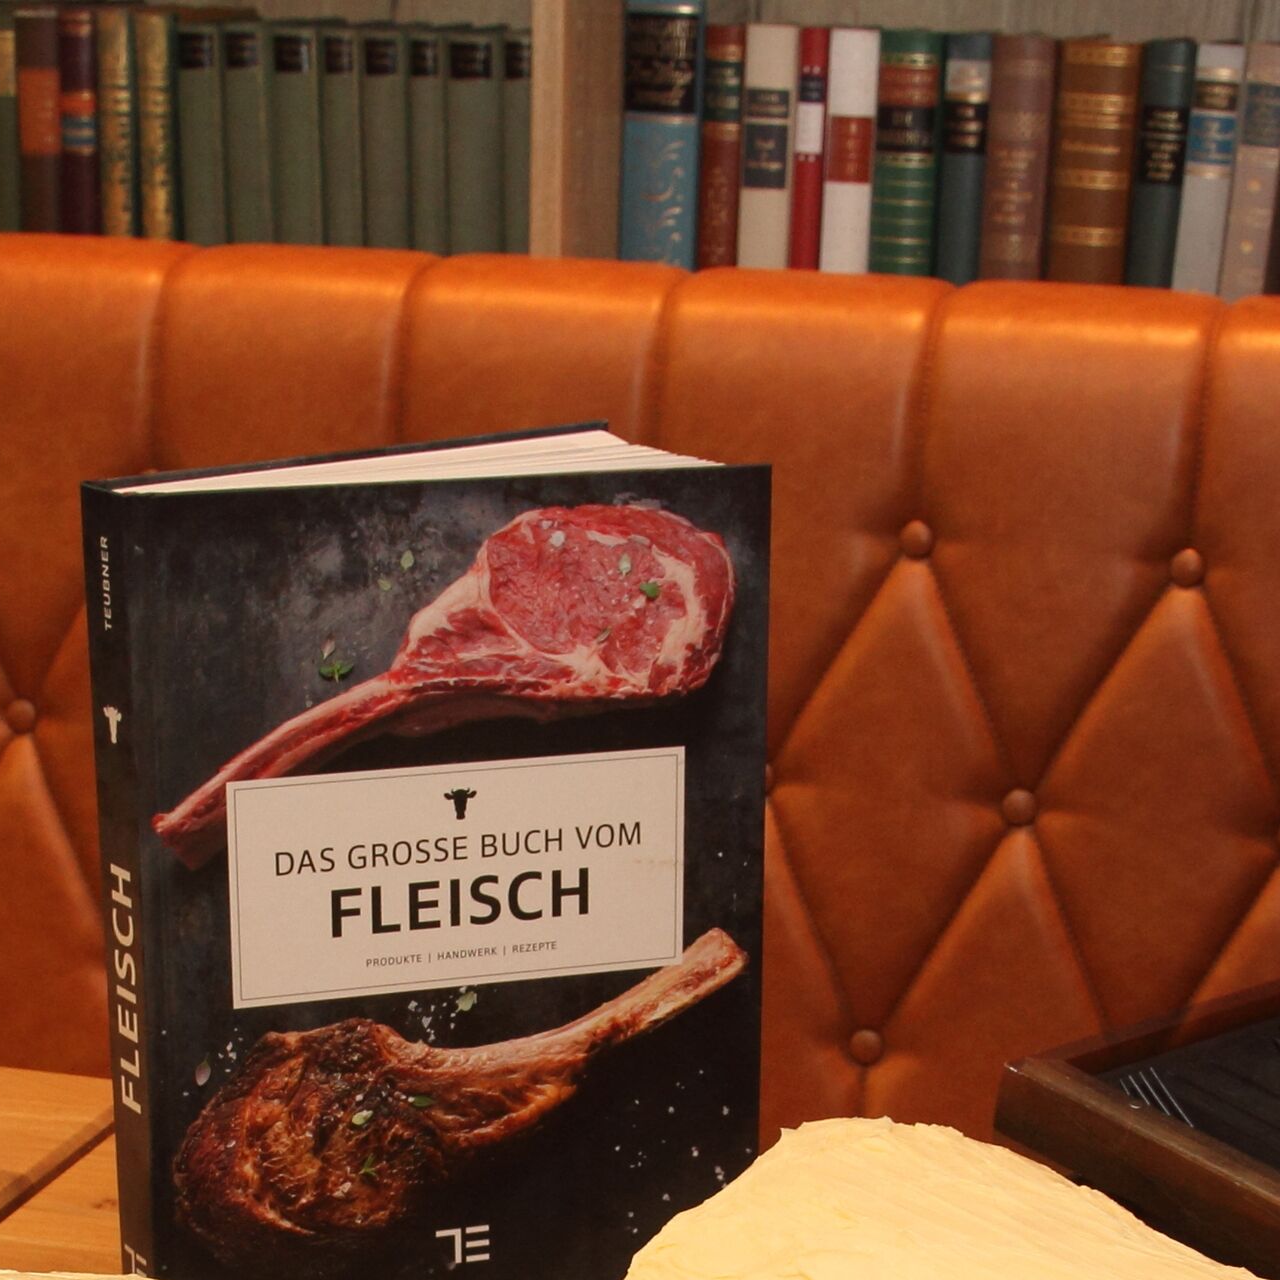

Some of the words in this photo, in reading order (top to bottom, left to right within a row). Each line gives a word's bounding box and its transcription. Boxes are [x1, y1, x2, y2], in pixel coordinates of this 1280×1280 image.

[99, 535, 113, 632] TEUBNER
[274, 847, 336, 876] DAS
[347, 836, 468, 870] GROSSE
[480, 828, 564, 858] BUCH
[575, 821, 642, 849] VOM
[330, 867, 590, 938] FLEISCH
[109, 863, 143, 1115] FLEISCH
[365, 954, 424, 968] PRODUKTE
[436, 946, 498, 962] HANDWERK
[511, 940, 558, 955] REZEPTE
